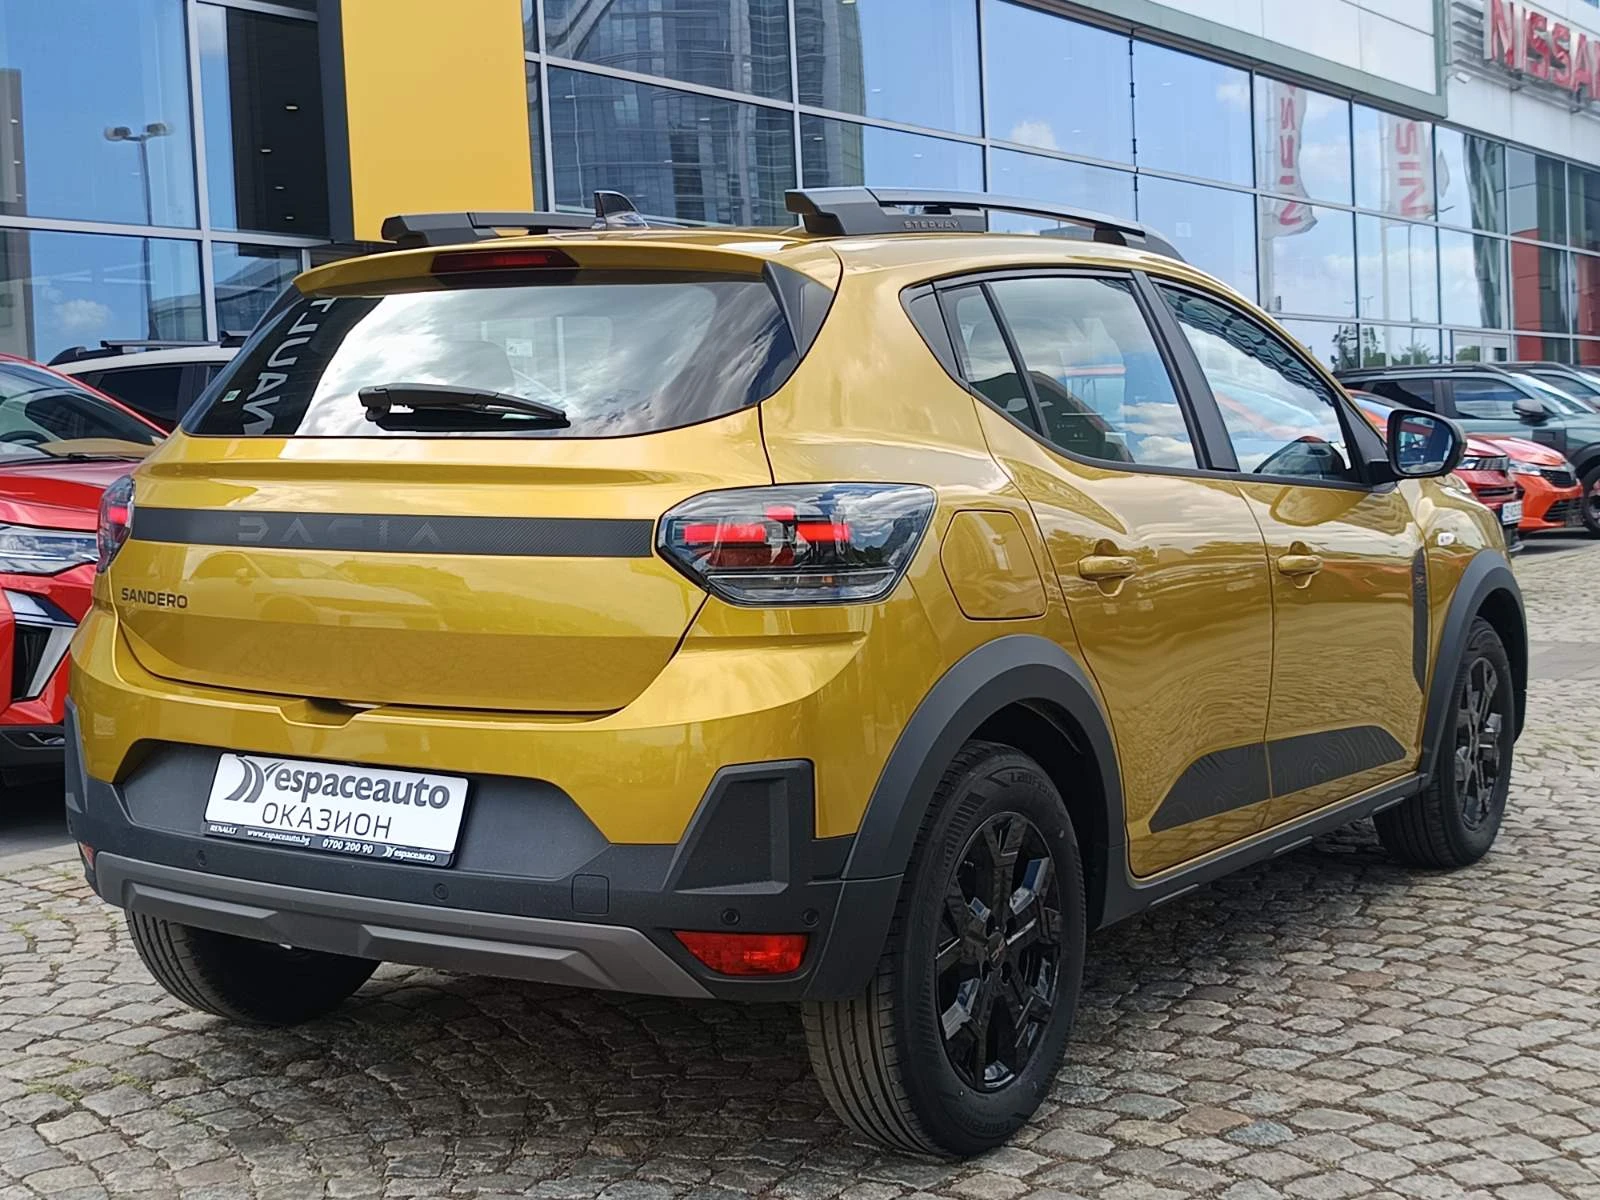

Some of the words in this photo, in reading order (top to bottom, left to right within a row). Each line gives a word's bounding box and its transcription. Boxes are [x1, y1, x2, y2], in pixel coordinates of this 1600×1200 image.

[238, 516, 440, 545] DACIA
[121, 587, 188, 609] SANDERO
[274, 768, 450, 809] espaceauto
[261, 802, 392, 839] ОКАЗИОН
[247, 829, 311, 846] www.espaceauto.bg
[322, 838, 344, 850] 0700
[344, 841, 361, 852] 200
[362, 844, 374, 854] 90
[393, 848, 437, 863] espaceauto
